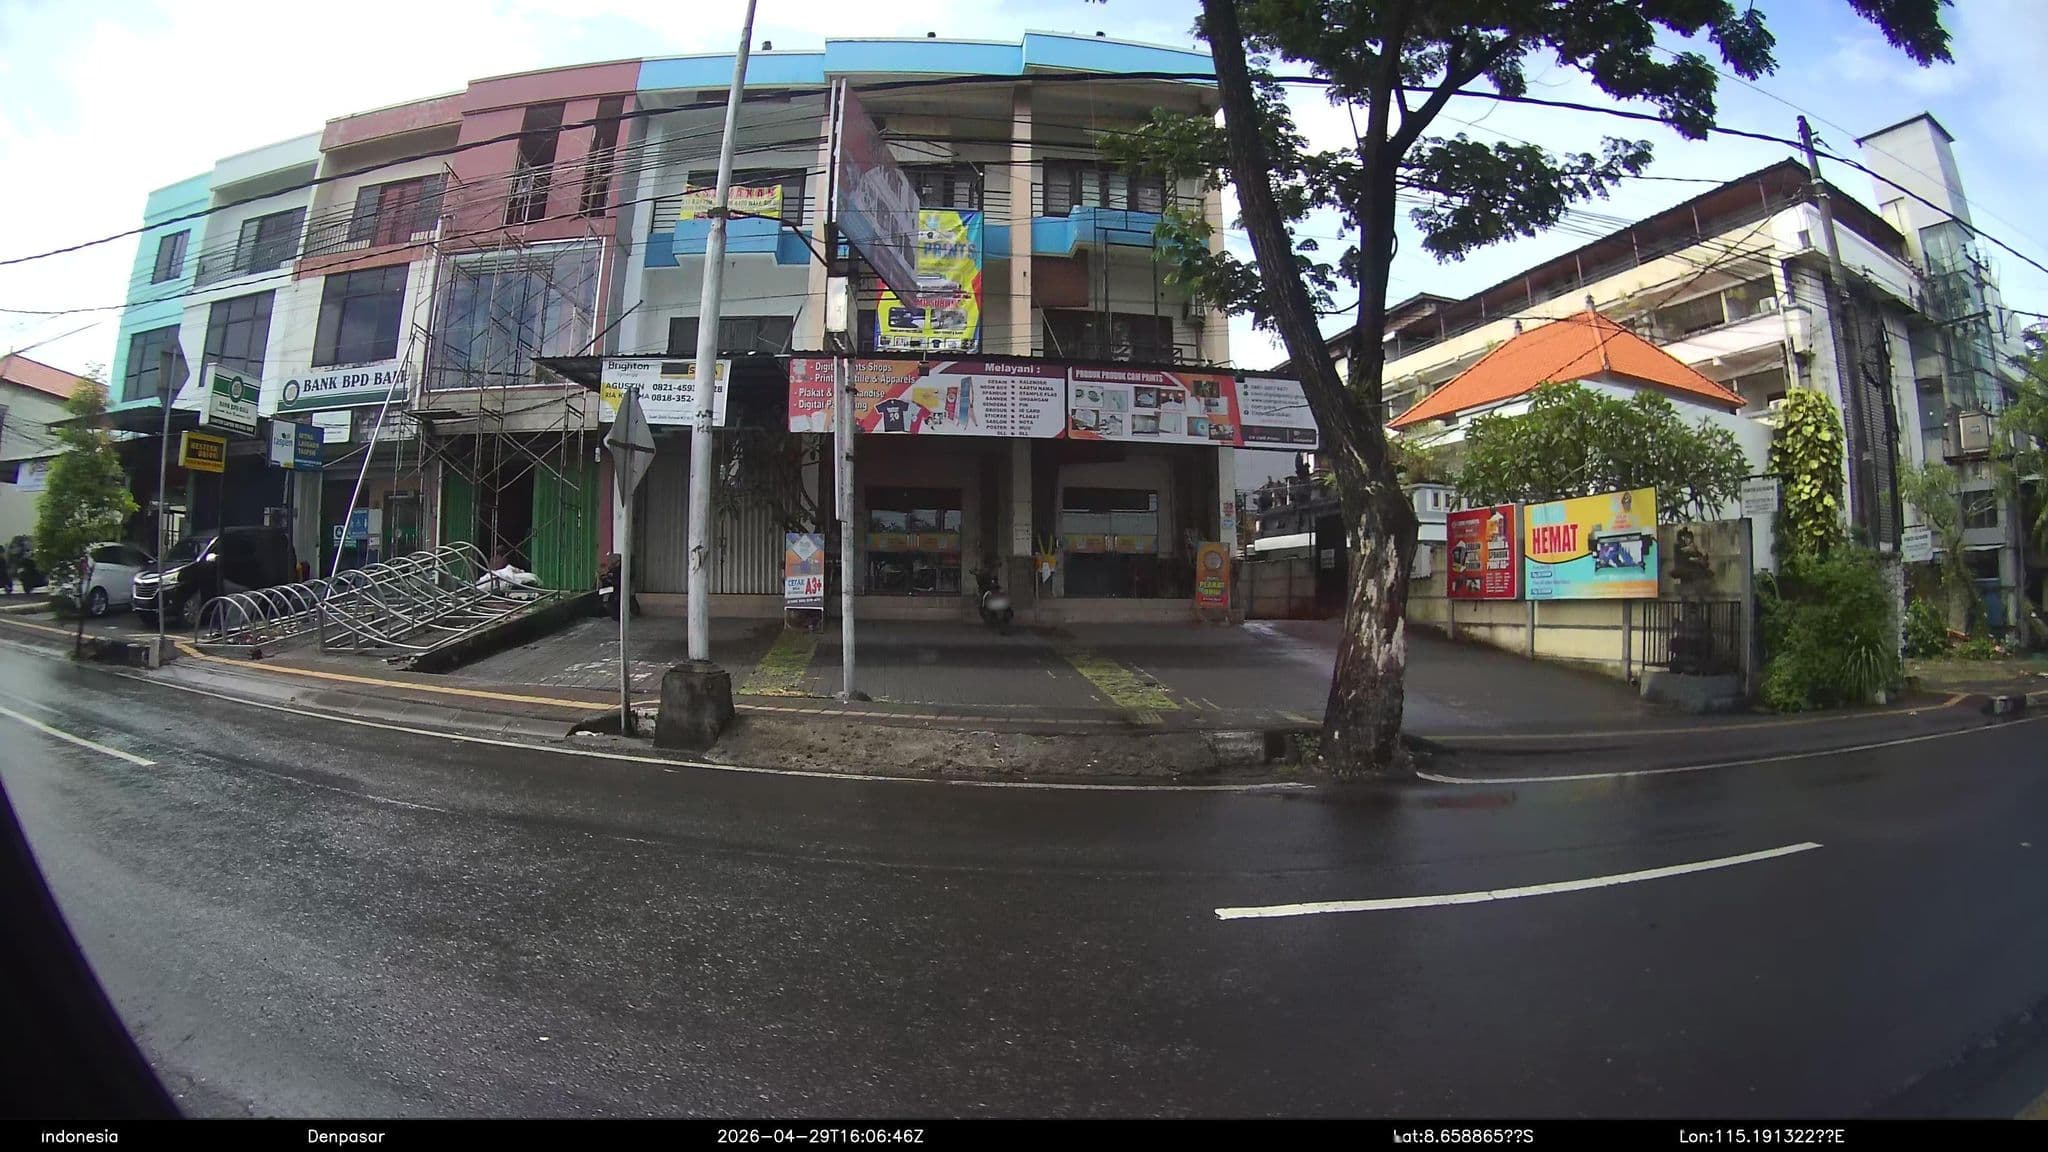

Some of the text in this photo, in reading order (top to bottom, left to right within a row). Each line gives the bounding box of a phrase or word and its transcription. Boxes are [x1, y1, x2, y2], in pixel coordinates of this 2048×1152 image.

[608, 361, 650, 372] Brighton
[815, 362, 835, 373] Digit
[867, 362, 892, 373] Shops
[985, 363, 1034, 375] Melayani
[303, 376, 338, 393] BANK
[342, 373, 370, 389] BPD
[815, 373, 834, 383] Print
[880, 374, 916, 385] Apparels
[798, 388, 825, 398] Plakat
[826, 389, 833, 397] &
[798, 400, 825, 410] Digital
[1532, 524, 1578, 554] HEMAT
[805, 576, 822, 595] A3+
